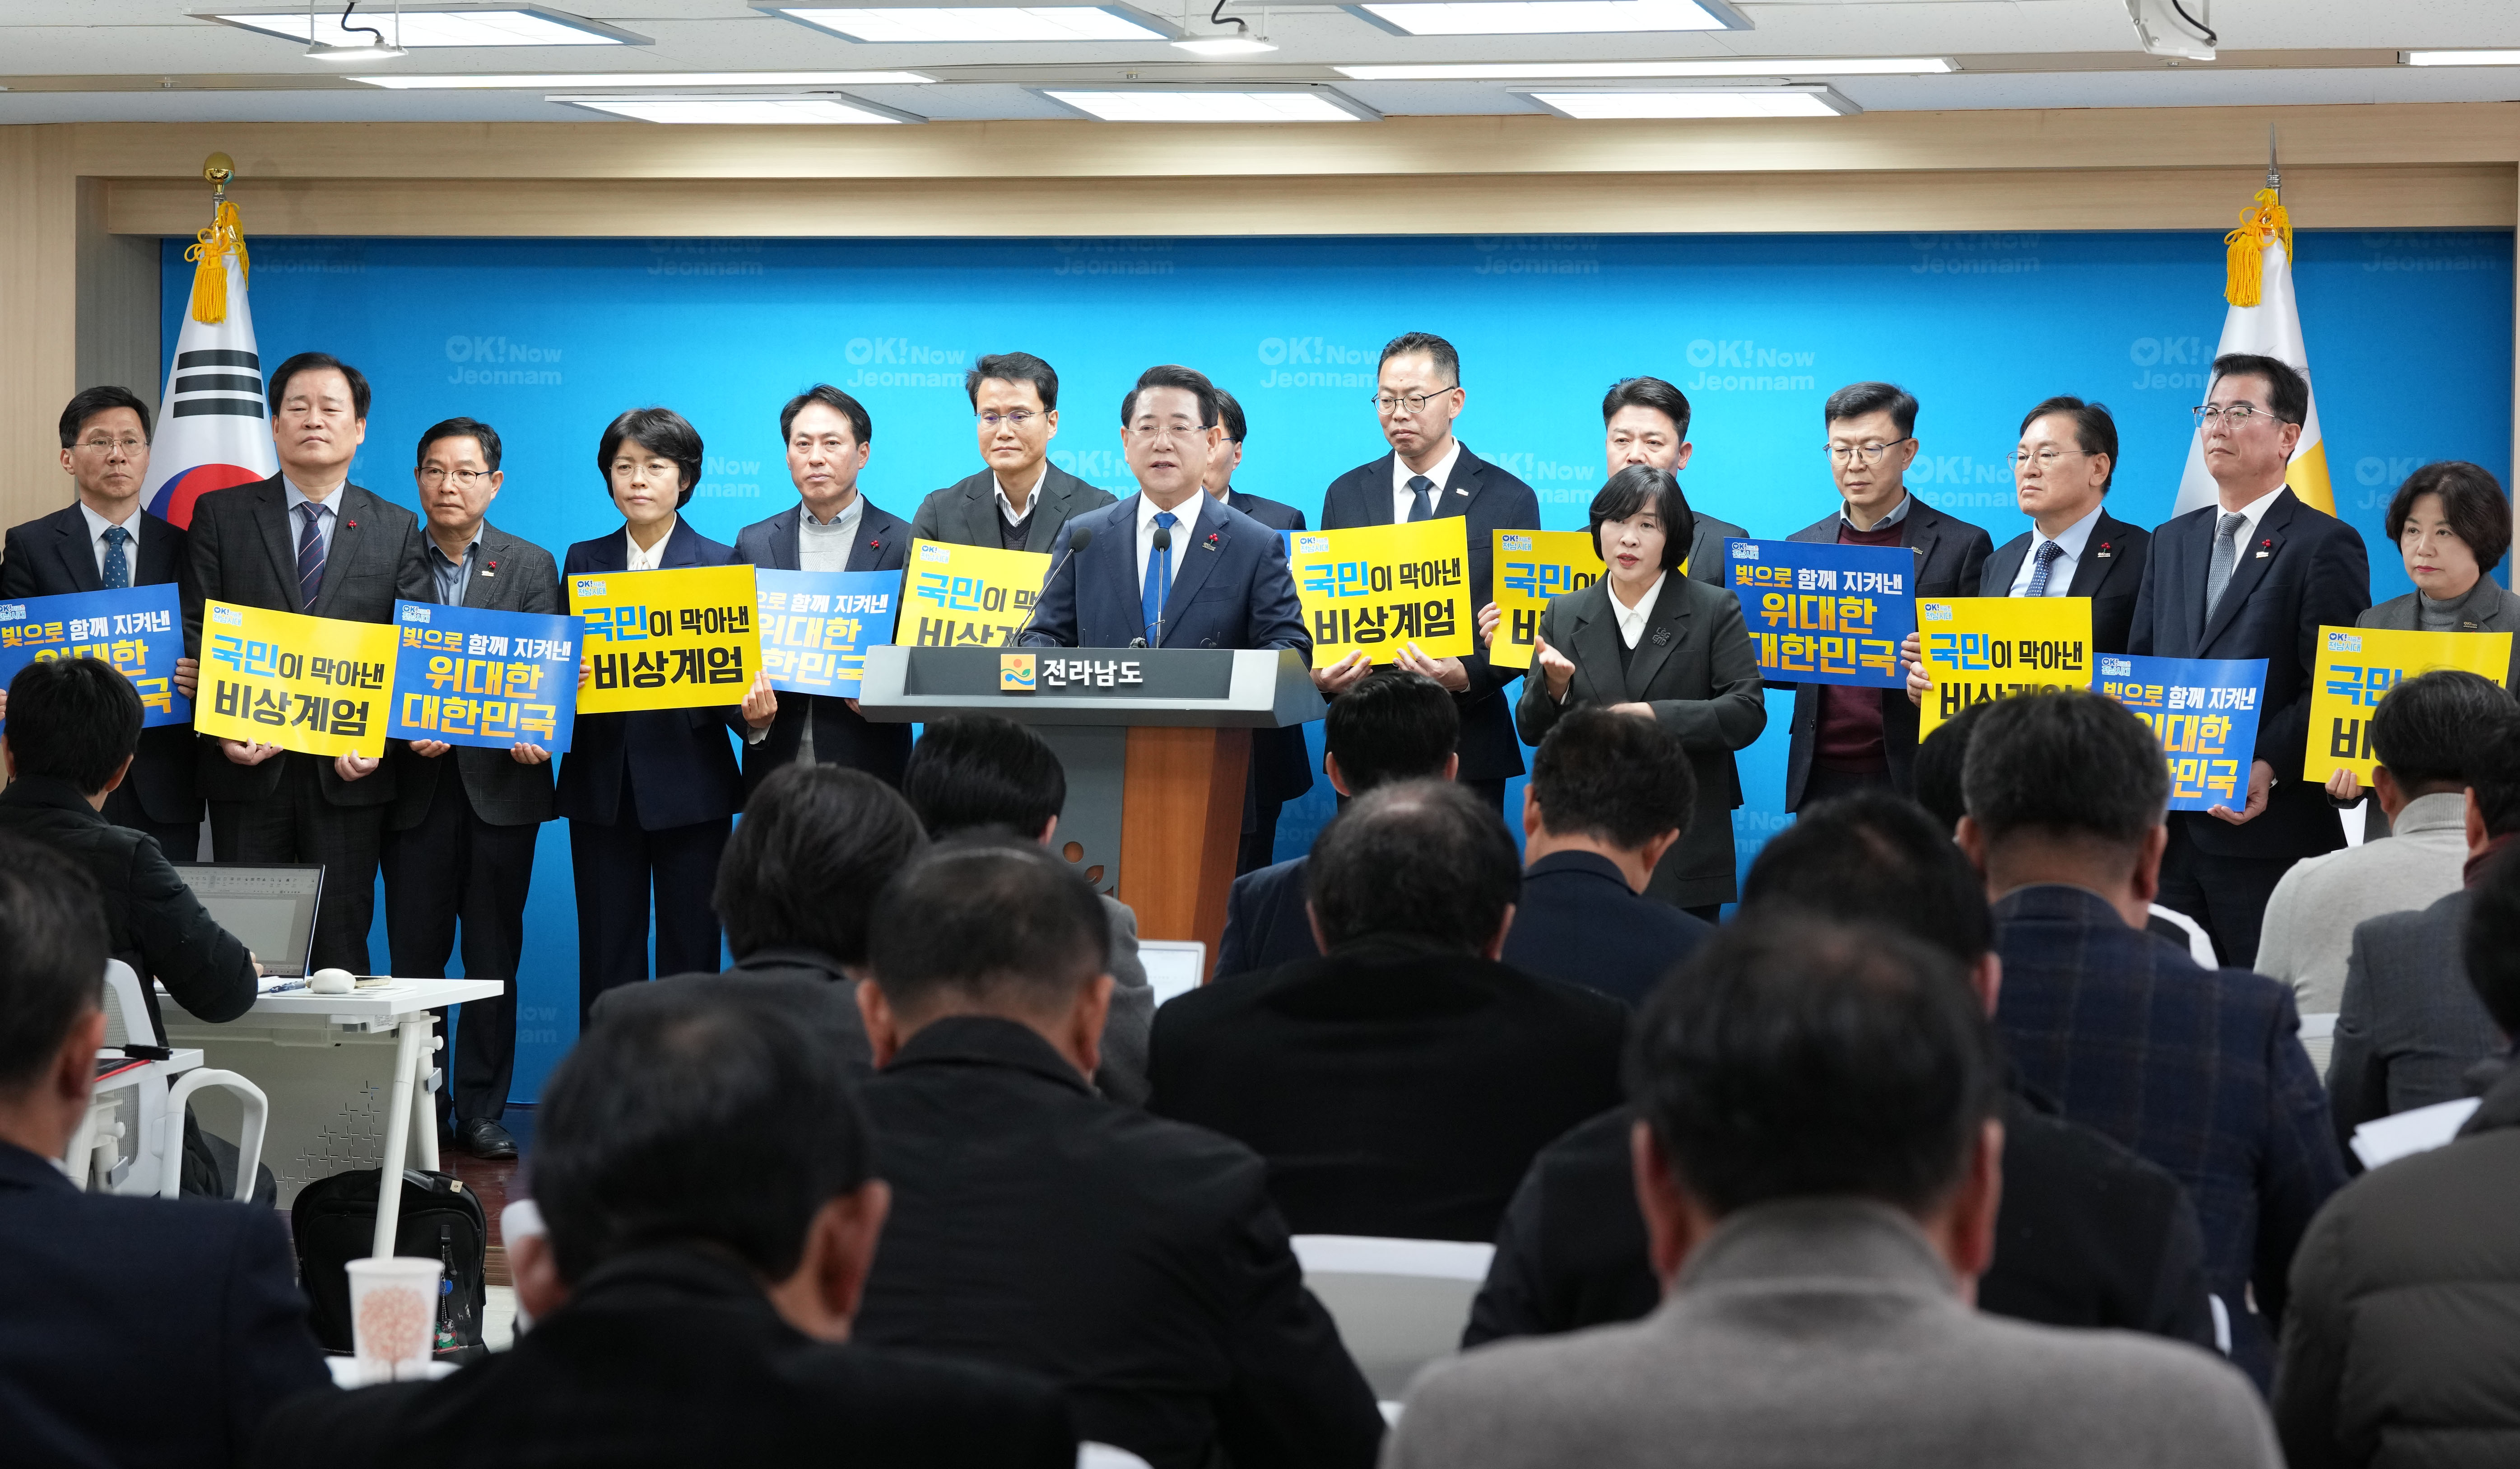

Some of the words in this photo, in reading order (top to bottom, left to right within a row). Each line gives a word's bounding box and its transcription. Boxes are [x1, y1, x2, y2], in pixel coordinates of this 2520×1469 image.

[647, 256, 763, 275] Jeonnam
[1054, 256, 1174, 275] Jeonnam
[1474, 255, 1600, 274] Jeonnam
[1910, 254, 2040, 274] Jeonnam
[2362, 252, 2496, 271] Jeonnam
[445, 335, 506, 363] OK!
[510, 344, 563, 362] Now
[845, 337, 908, 365] OK!
[911, 345, 966, 364] Now
[1258, 337, 1323, 365] OK!
[1326, 345, 1382, 364] Now
[1686, 339, 1754, 368] OK!
[1757, 348, 1815, 367] Now
[2130, 337, 2200, 366] OK!
[447, 366, 562, 384] Jeonnam
[846, 368, 965, 387] Jeonnam
[1260, 369, 1377, 387] Jeonnam
[1688, 372, 1814, 390] Jeonnam
[2132, 370, 2211, 389] Jeon
[707, 456, 761, 475] Now
[1048, 450, 1112, 478] OK!
[1537, 461, 1595, 480] Now
[1903, 455, 1972, 484] OK!
[1976, 464, 2013, 484] No
[693, 483, 760, 497] nnam
[921, 545, 937, 554] OK!
[1300, 536, 1315, 545] OK!
[1300, 544, 1329, 553] 전남시대
[1502, 542, 1532, 551] 전남시대
[1732, 550, 1759, 560] 전남시대
[1304, 561, 1392, 598] 국민이
[1399, 557, 1461, 590] 막아낸
[1736, 564, 1792, 588] 빛으로
[1798, 568, 1837, 591] 함께
[1843, 571, 1902, 595] 지켜낸
[577, 587, 606, 597] 전남시대
[757, 591, 787, 610] 으로
[791, 593, 830, 613] 함께
[834, 594, 889, 614] 지켜낸
[916, 572, 1007, 612] 국민이
[213, 614, 242, 626] 전남시대
[214, 606, 230, 616] OK!
[402, 605, 418, 614] OK!
[402, 612, 430, 623] 전남시대
[1761, 593, 1877, 634] 위대한
[1925, 611, 1952, 620] 전남시대
[2, 621, 65, 648] 빛으로
[70, 616, 109, 641] 함께
[113, 610, 171, 635] 지켜낸
[583, 606, 673, 642] 국민이
[680, 606, 749, 635] 막아낸
[758, 613, 862, 651] 위대한
[917, 617, 1025, 647] 비상
[1315, 598, 1455, 645] 비상계엄
[403, 627, 463, 652] 빛으로
[468, 634, 508, 656] 함께
[513, 638, 572, 661] 지켜낸
[2328, 642, 2361, 653] 전남시대
[2329, 632, 2347, 641] OK!
[212, 634, 303, 680] 국민이
[311, 657, 385, 690] 막아낸
[1748, 632, 1896, 677] 대한민국
[1930, 633, 2011, 670] 국민이
[2019, 641, 2082, 671] 막아낸
[2102, 658, 2119, 666] OK!
[426, 656, 544, 700] 위대한
[594, 646, 743, 690] 비상계엄
[762, 648, 866, 688] 한민국
[1042, 659, 1143, 686] 전라남도
[2102, 666, 2131, 676] 전남시대
[2102, 681, 2163, 707] 빛으로
[2168, 686, 2205, 709] 함께
[2208, 687, 2257, 710] 지켜낸
[2326, 665, 2402, 707] 국민
[215, 680, 369, 737] 비상계엄
[401, 692, 557, 740] 대한민국
[2167, 759, 2238, 799] 민국
[516, 1003, 558, 1021] ow
